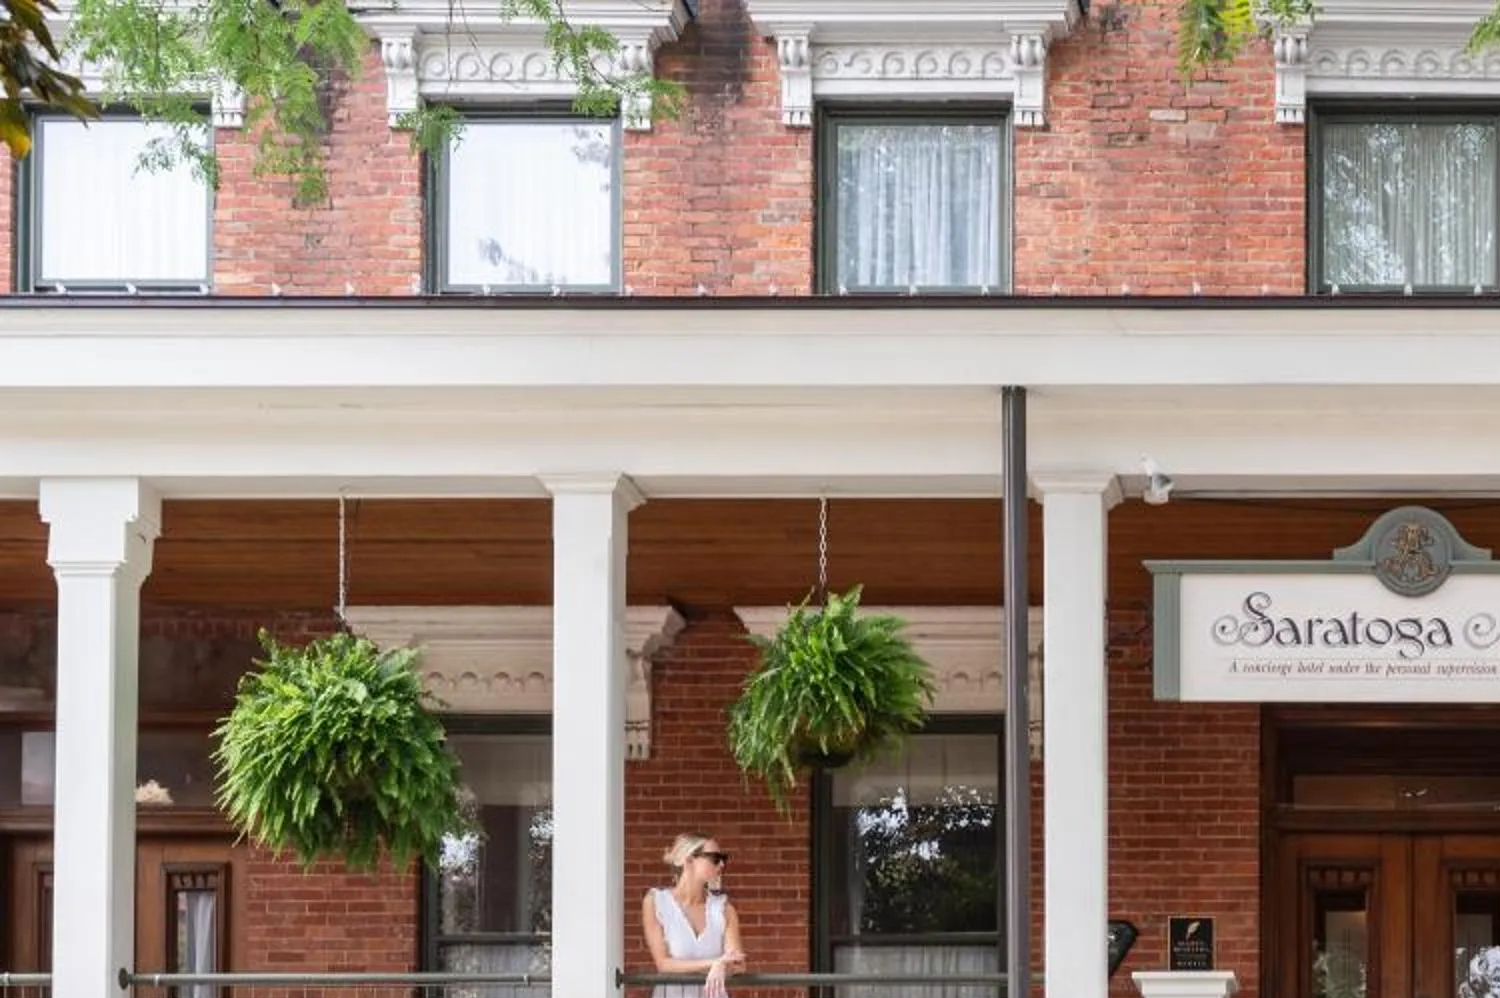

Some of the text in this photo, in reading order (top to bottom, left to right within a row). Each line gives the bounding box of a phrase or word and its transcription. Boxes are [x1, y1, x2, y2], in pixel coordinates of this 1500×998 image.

[1211, 591, 1453, 660] Saratoga
[1229, 661, 1238, 673] A
[1328, 661, 1360, 674] under
[1365, 661, 1382, 674] the
